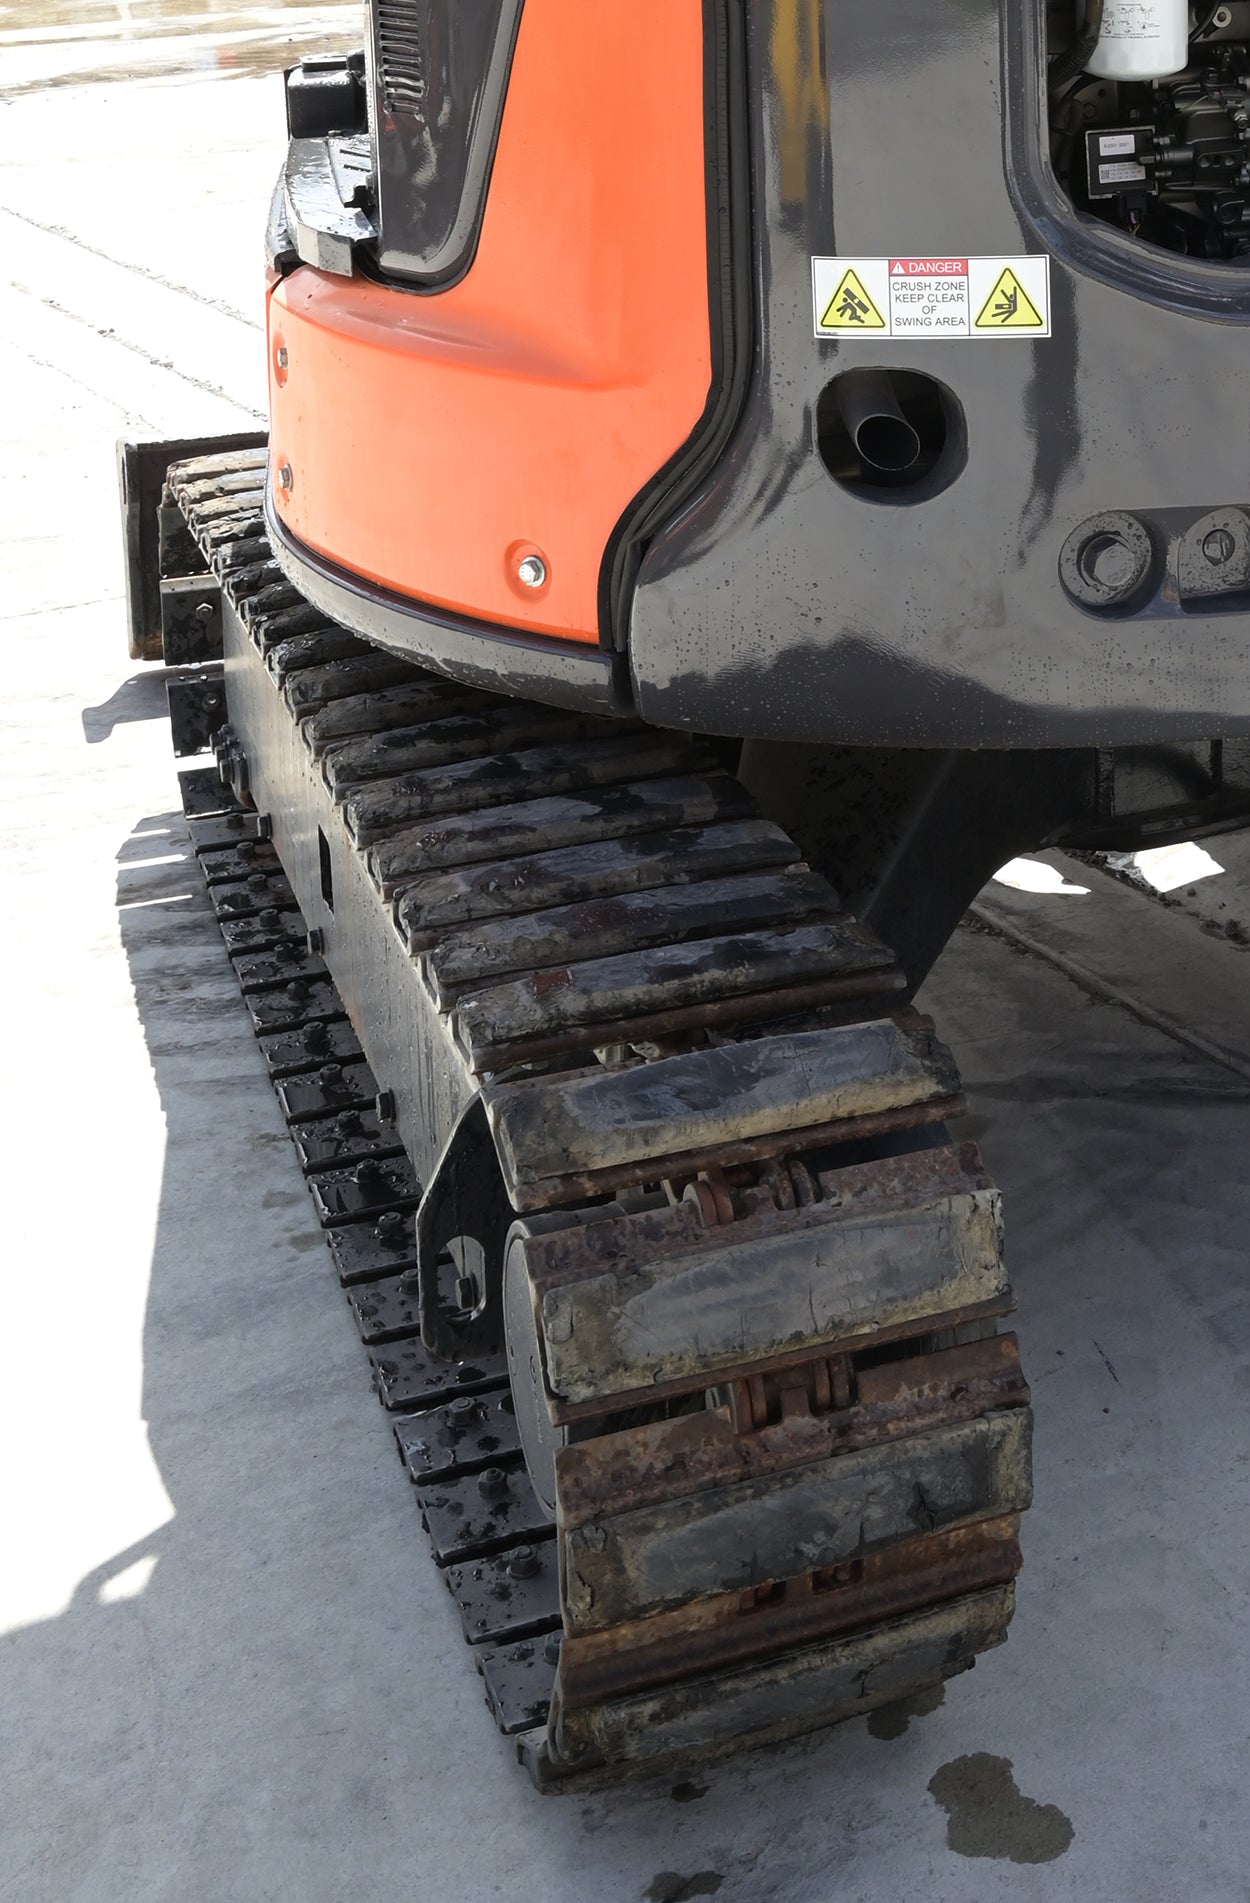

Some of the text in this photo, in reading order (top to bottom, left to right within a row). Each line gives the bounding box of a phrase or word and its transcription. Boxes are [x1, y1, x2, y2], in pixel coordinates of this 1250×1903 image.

[909, 262, 962, 273] DANGER
[892, 281, 966, 291] CRUSH ZONE
[895, 294, 965, 303] KEEP CLEAR
[921, 305, 937, 314] OF
[894, 317, 966, 326] SWING AREA
